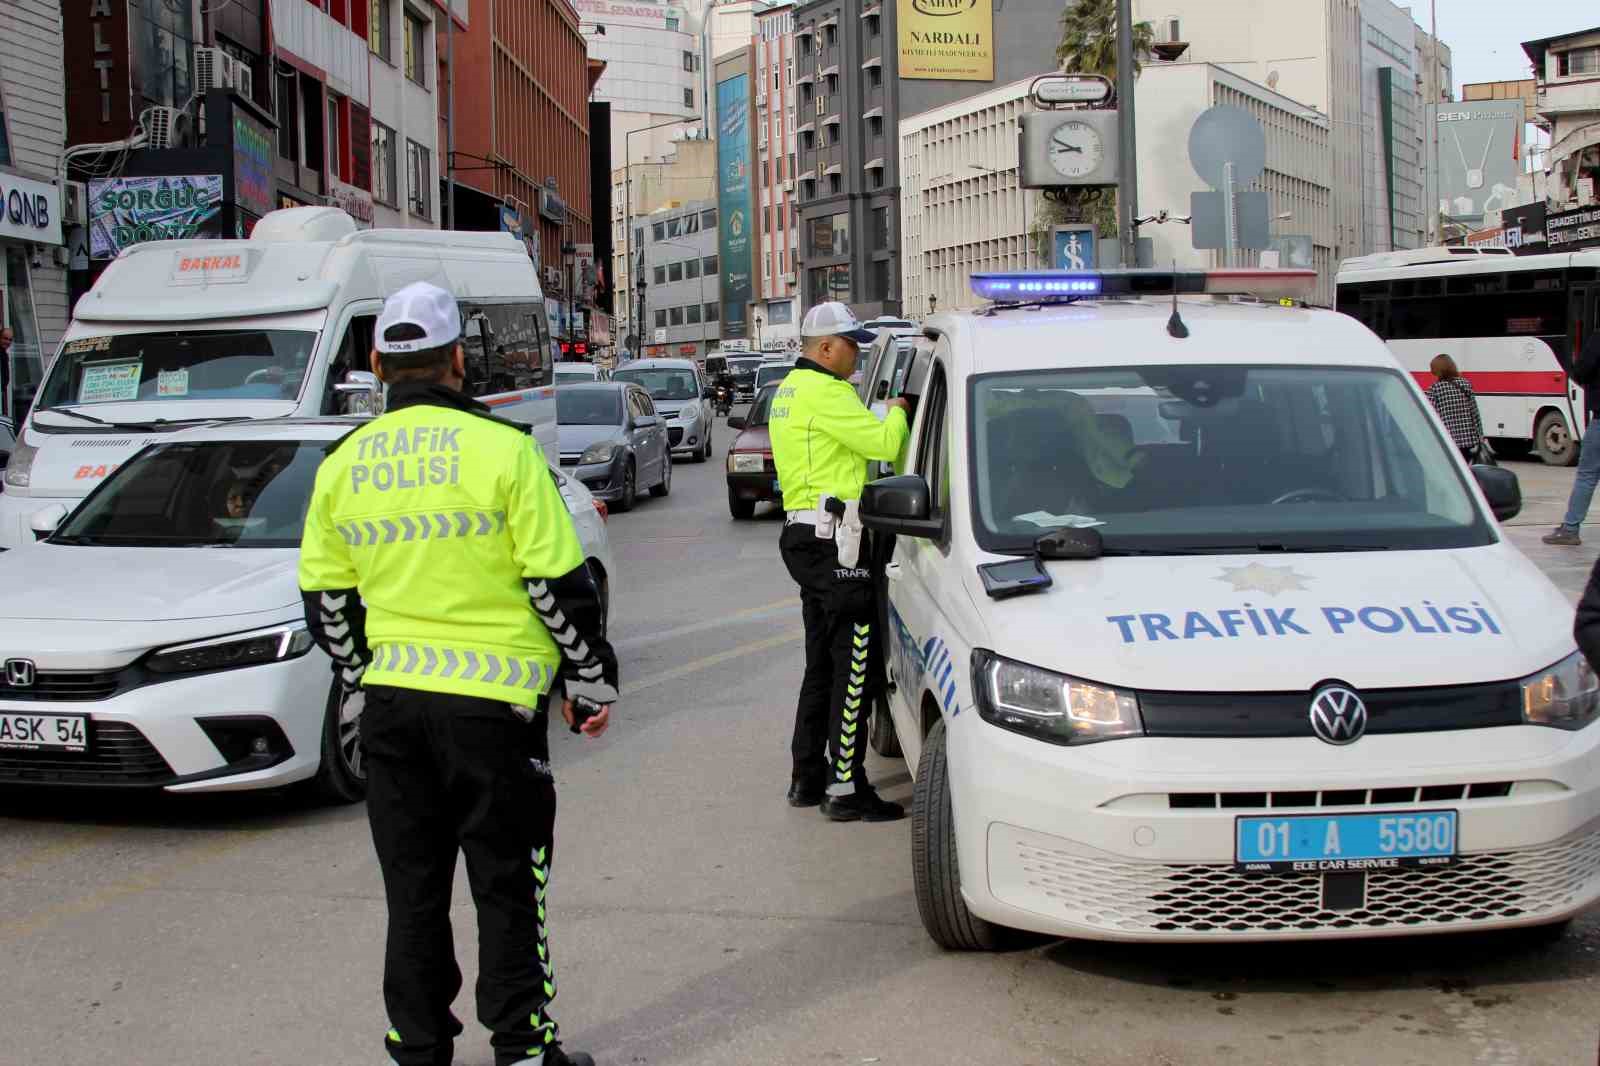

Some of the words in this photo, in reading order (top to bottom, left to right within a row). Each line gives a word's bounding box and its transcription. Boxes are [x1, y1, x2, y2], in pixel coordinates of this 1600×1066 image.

[911, 31, 979, 45] NARDALI
[1437, 112, 1470, 121] GEN
[9, 189, 49, 228] QNB
[179, 255, 241, 272] BARKAL
[1106, 602, 1312, 643] TRAFİK
[1320, 600, 1504, 635] POLİSİ
[0, 717, 46, 741] ASK
[56, 719, 84, 742] 54
[1257, 821, 1291, 857] 01
[1323, 820, 1342, 855] A
[1378, 816, 1450, 852] 5580
[1292, 861, 1317, 871] ECE
[1319, 860, 1345, 870] CAR
[1349, 858, 1400, 869] SERVICE
